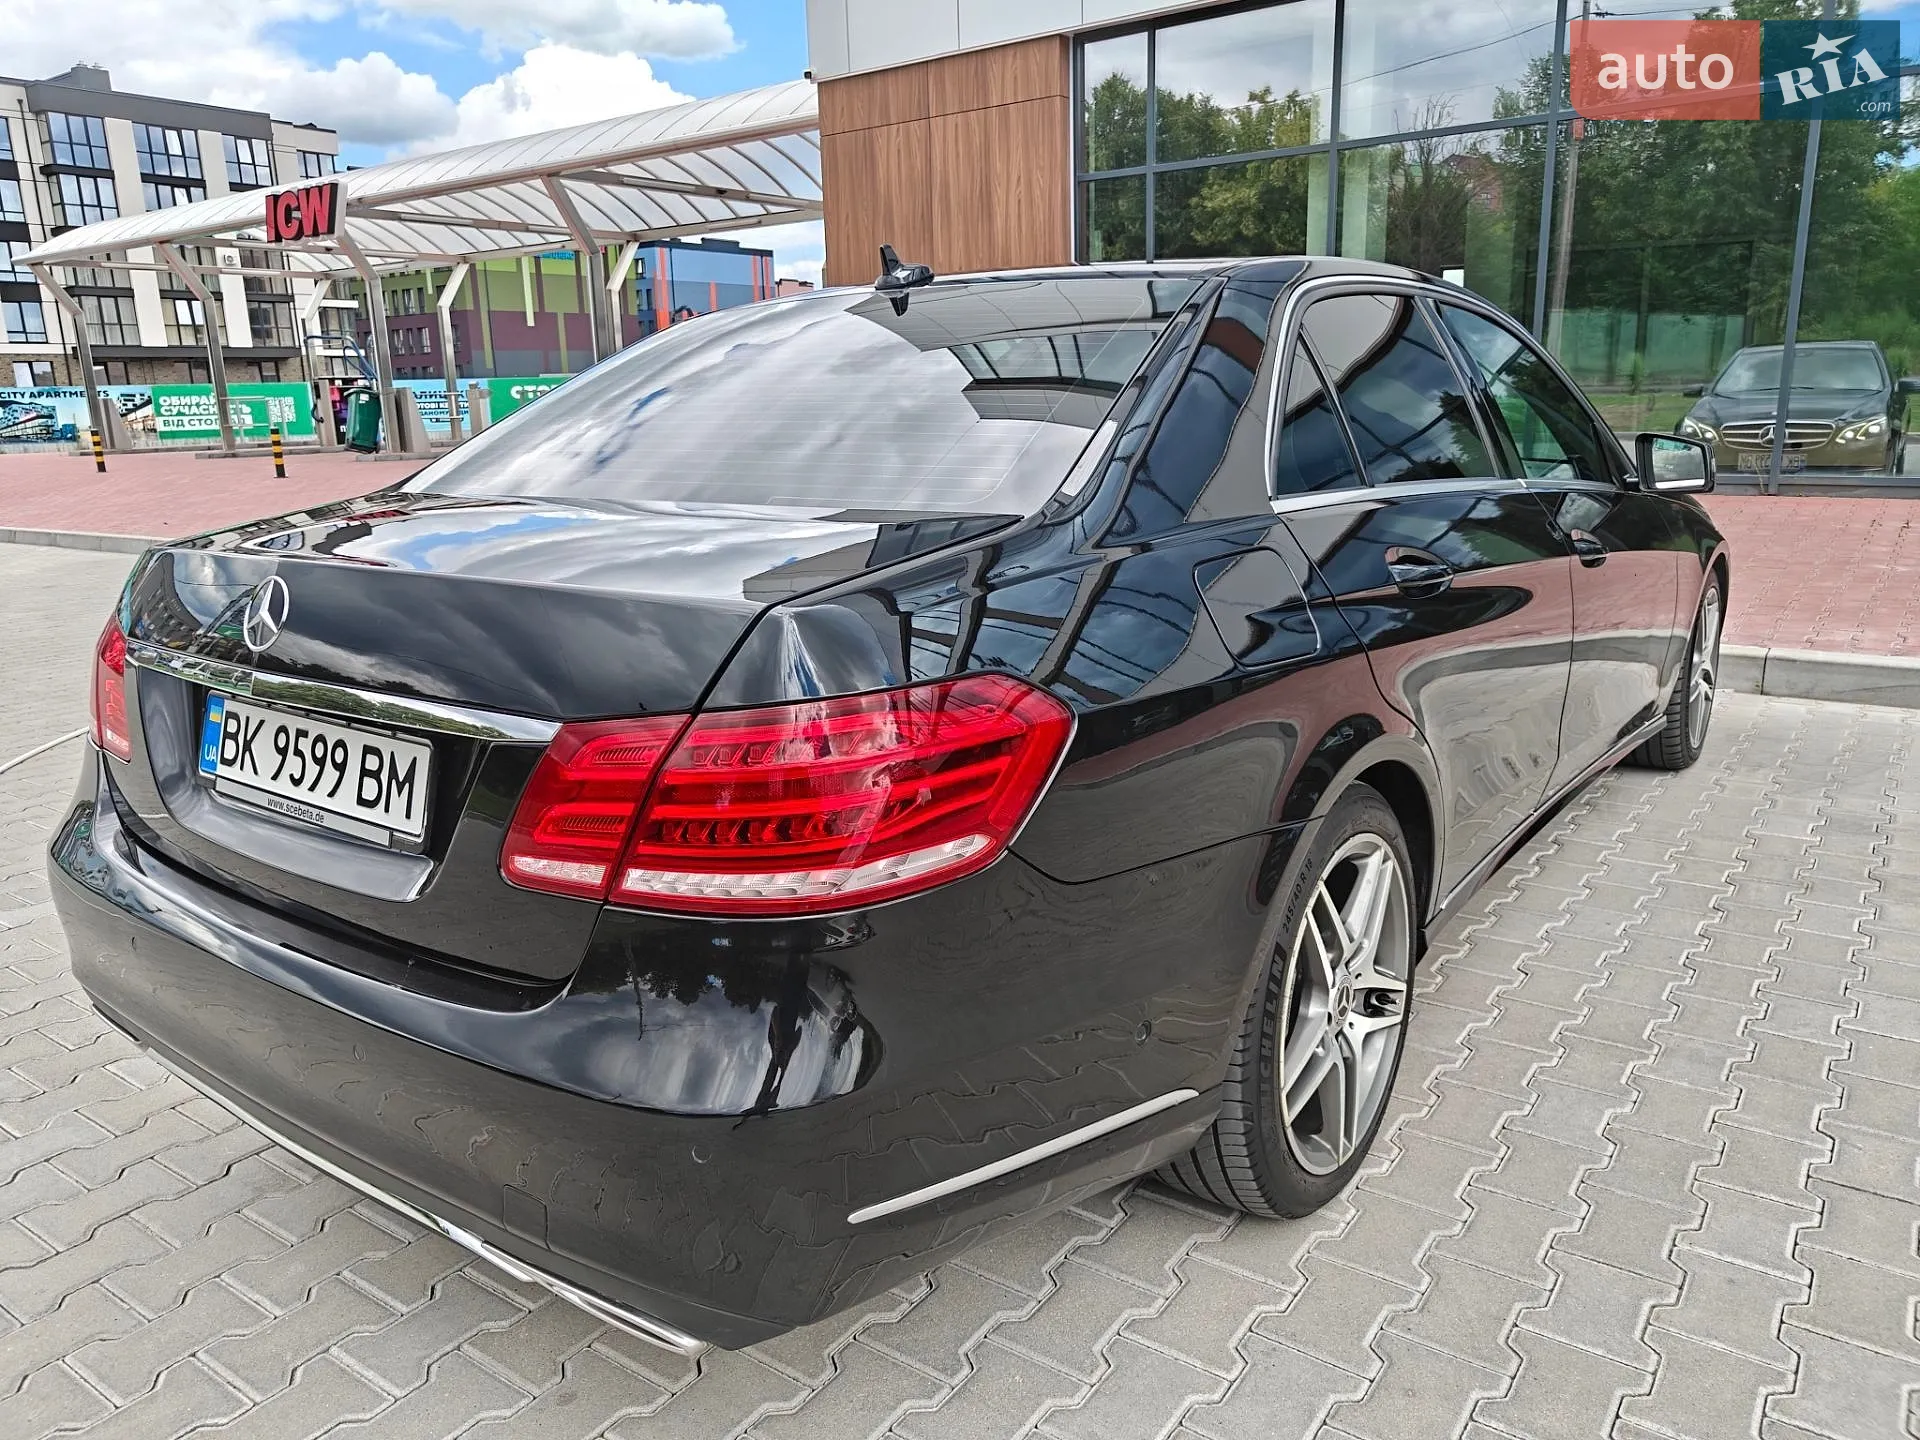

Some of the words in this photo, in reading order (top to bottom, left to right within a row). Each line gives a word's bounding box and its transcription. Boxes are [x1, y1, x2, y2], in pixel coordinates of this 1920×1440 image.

[265, 183, 337, 243] ICW
[29, 390, 110, 399] APARTMETS
[163, 418, 185, 427] ВІД
[204, 743, 217, 763] UA
[219, 711, 265, 776] BK
[270, 725, 349, 798] 9599
[356, 743, 417, 819] BM
[267, 797, 324, 824] www.scebeta.de
